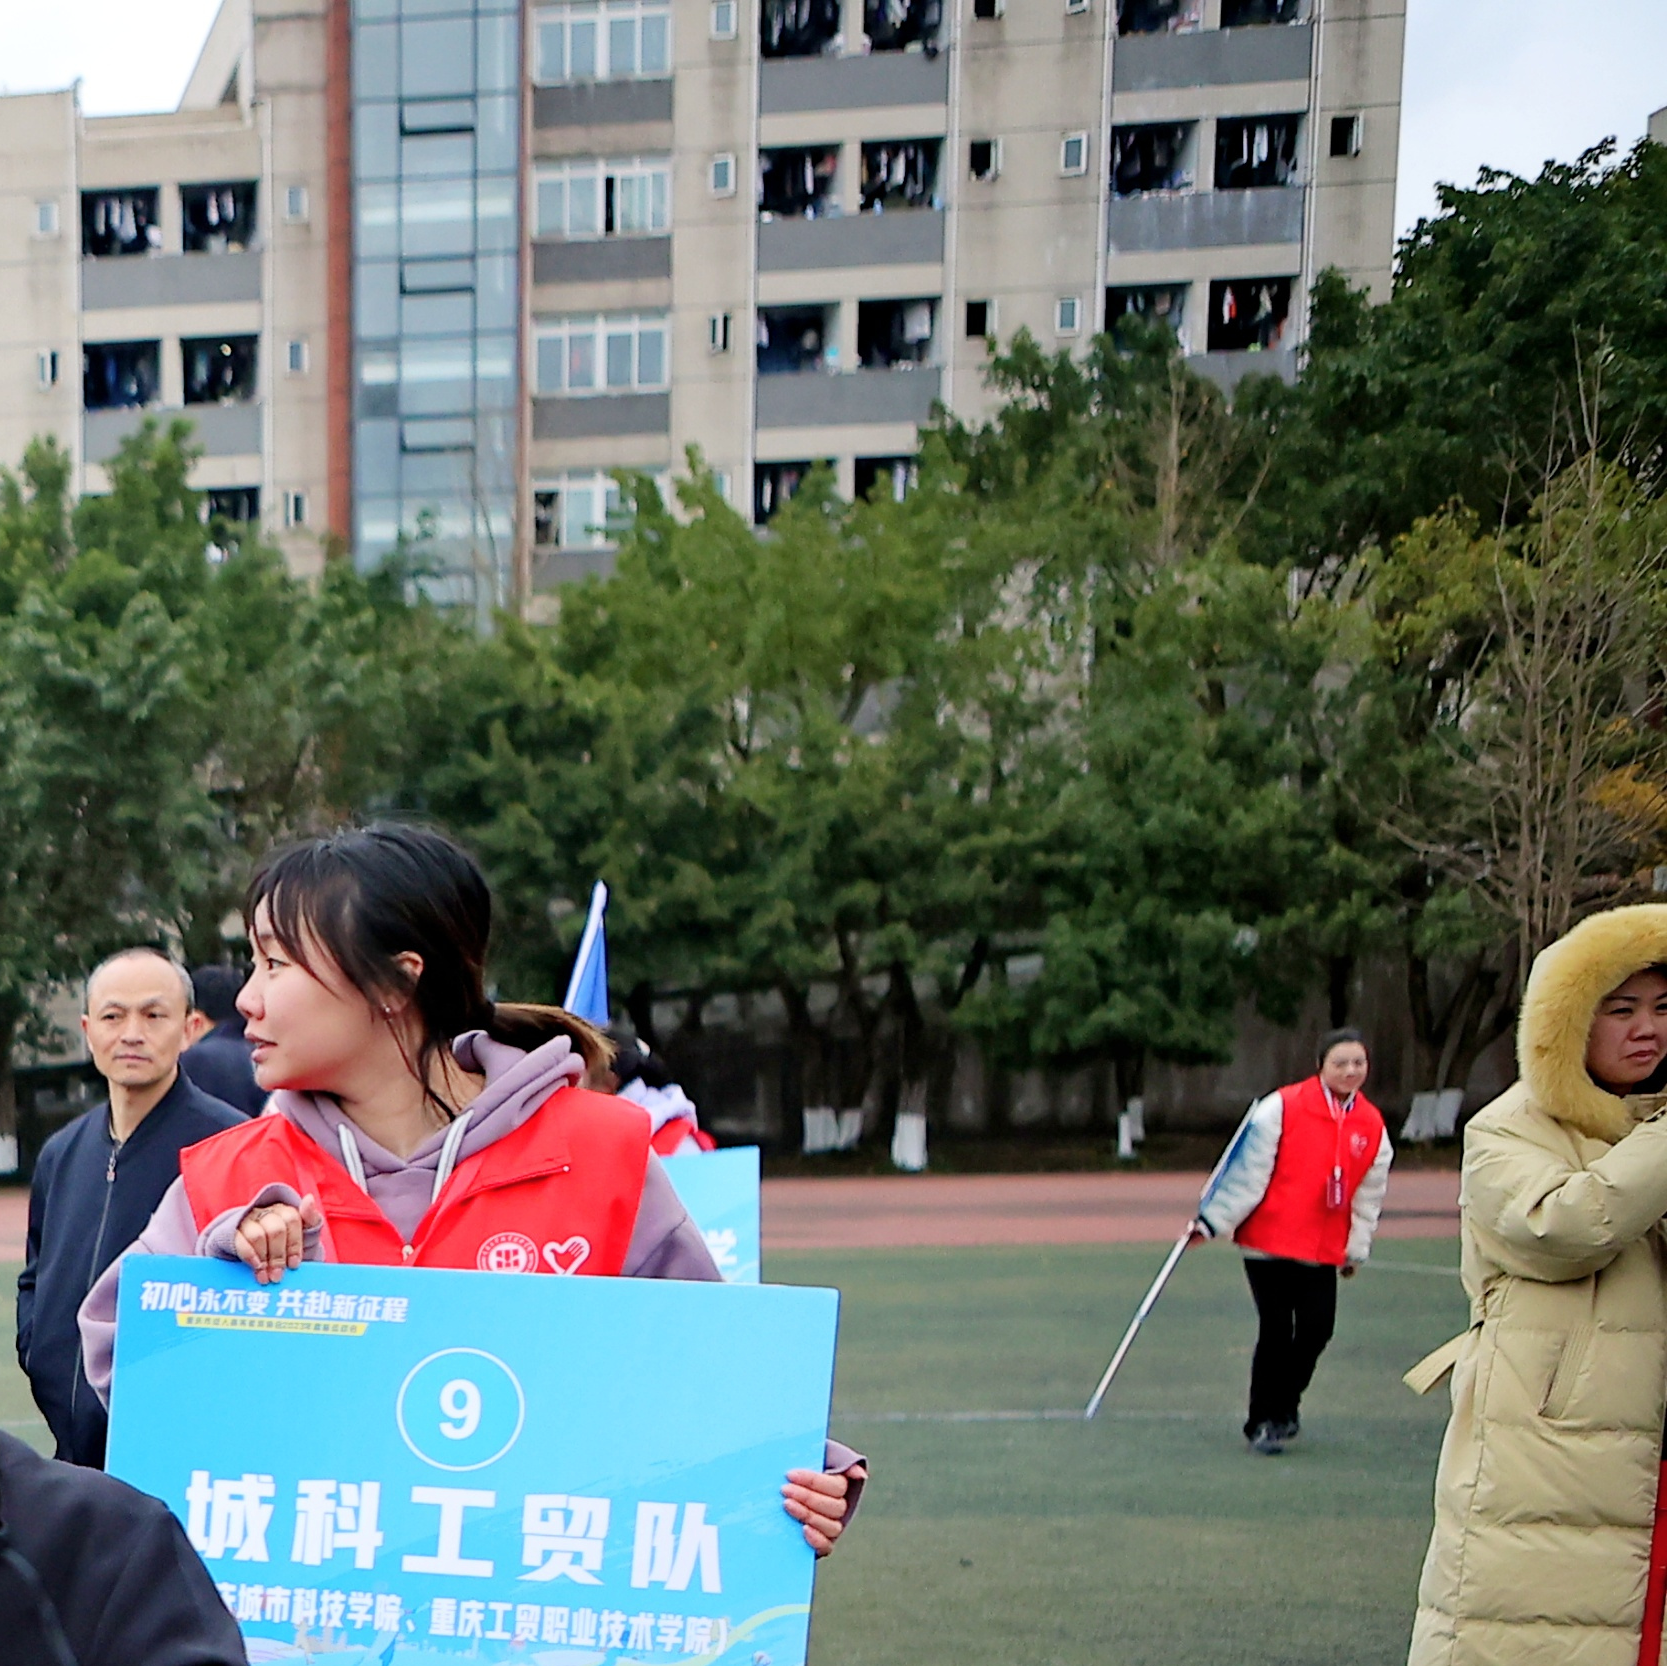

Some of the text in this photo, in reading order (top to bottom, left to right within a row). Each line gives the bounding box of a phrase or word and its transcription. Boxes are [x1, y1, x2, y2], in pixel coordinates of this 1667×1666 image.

[140, 1280, 410, 1323] 初心永不变 共赴新征程
[438, 1378, 482, 1440] 9
[185, 1469, 722, 1594] 城科工贸队
